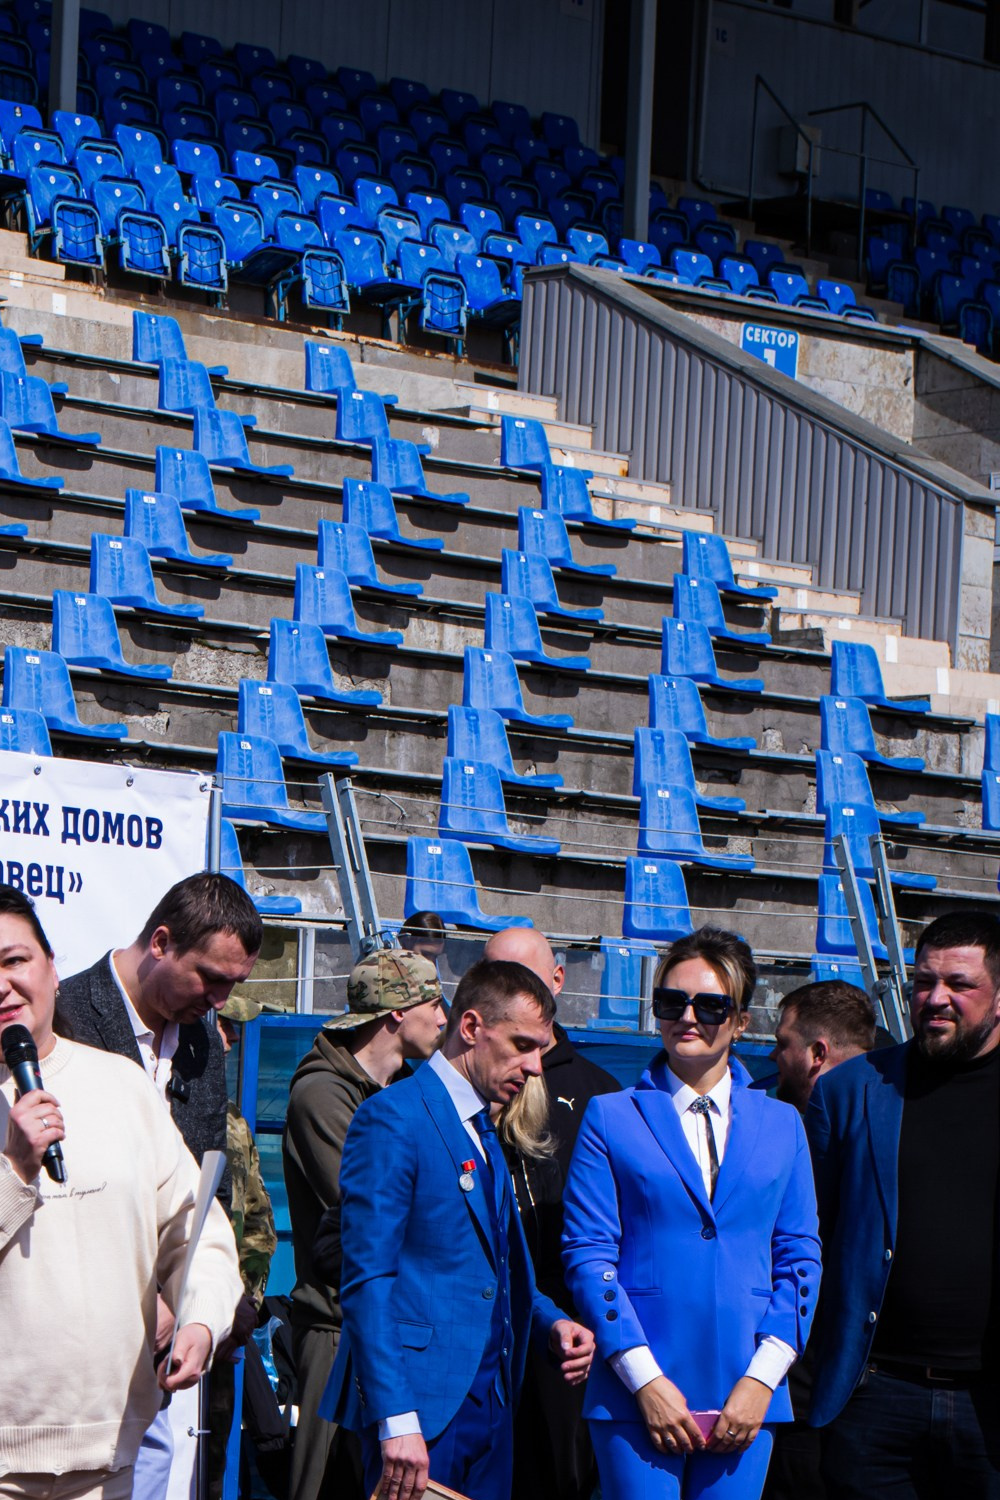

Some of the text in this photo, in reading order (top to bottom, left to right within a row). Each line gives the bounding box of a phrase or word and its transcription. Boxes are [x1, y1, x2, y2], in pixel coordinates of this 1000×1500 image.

[745, 326, 796, 349] СЕКТОР
[763, 348, 776, 368] 1
[60, 806, 164, 850] домов
